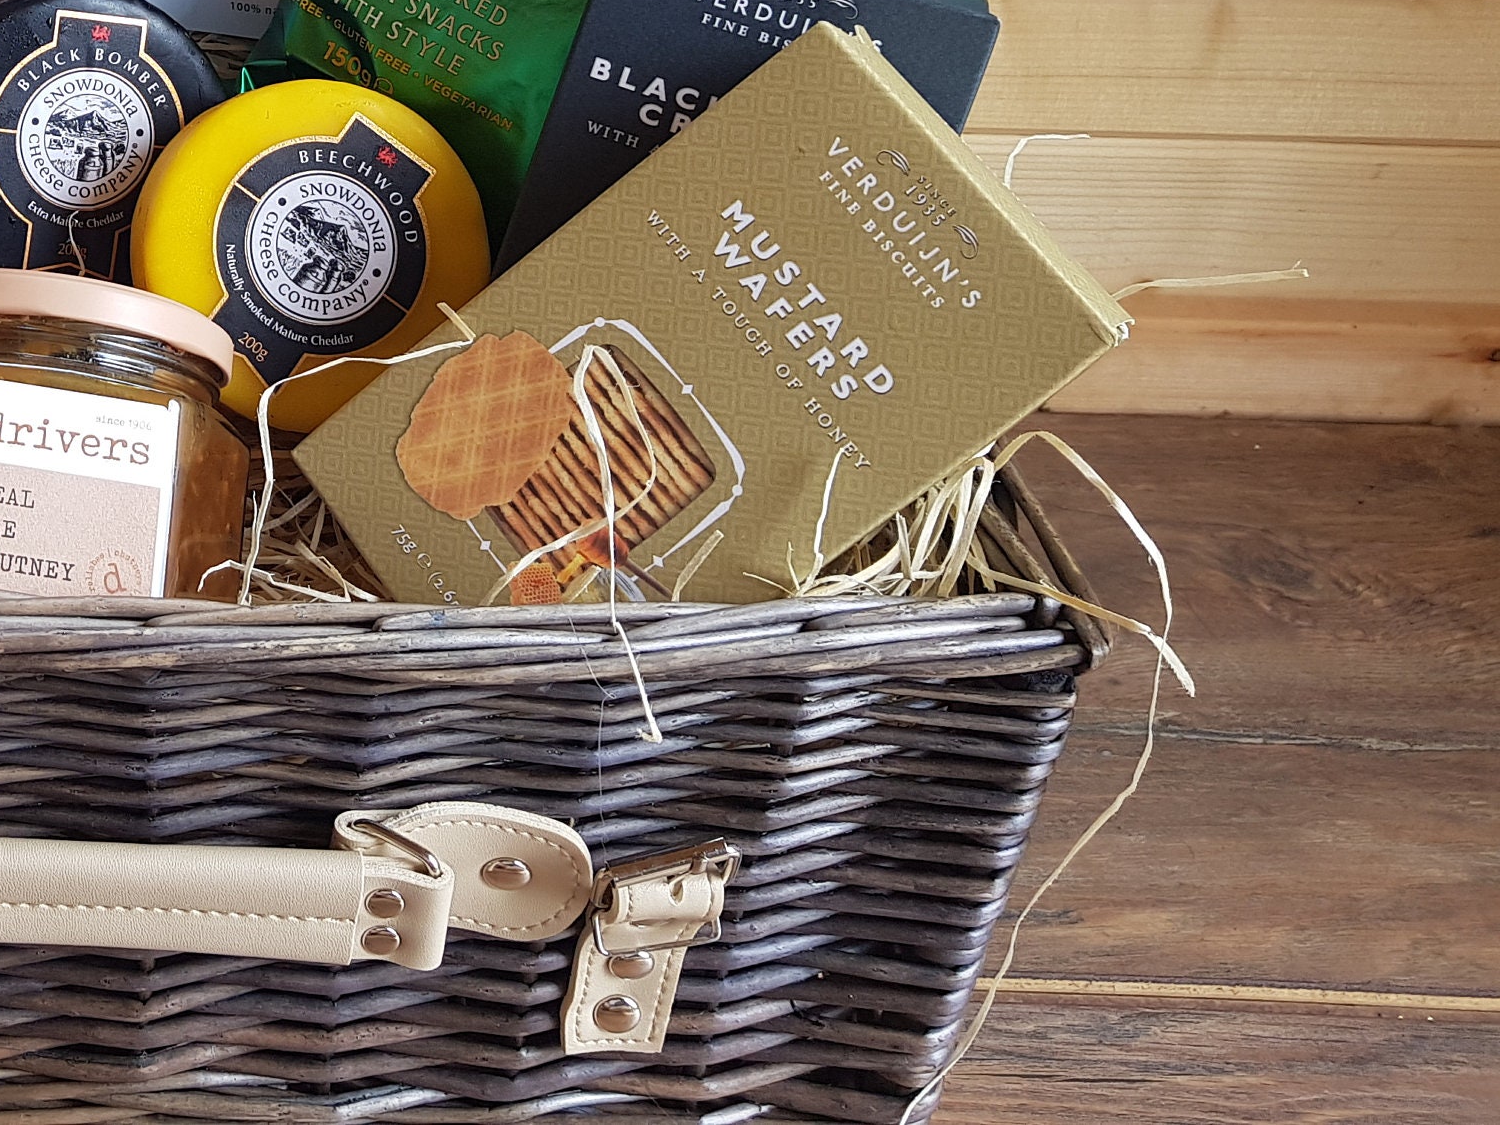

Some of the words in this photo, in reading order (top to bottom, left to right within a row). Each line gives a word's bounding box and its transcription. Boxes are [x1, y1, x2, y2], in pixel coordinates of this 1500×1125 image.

[230, 1, 261, 14] 100%
[701, 12, 752, 38] FINE
[323, 40, 372, 88] 150g
[333, 18, 375, 53] GLUTEN
[375, 48, 412, 75] FREE
[423, 75, 514, 131] VEGETARIAN
[387, 21, 466, 76] STYLE
[17, 48, 81, 92] BLACK
[94, 48, 167, 107] BOMBER
[590, 57, 718, 111] BLAC
[587, 120, 640, 148] WITH
[27, 200, 49, 220] Extra
[86, 211, 125, 228] Cheddar
[298, 149, 419, 243] BEECHWOOD
[826, 136, 982, 309] VERDUIJN'S
[904, 185, 947, 227] 1935
[916, 175, 956, 217] SINCE
[819, 170, 862, 216] FINE
[862, 219, 945, 310] BISCUITS
[225, 243, 245, 292] Naturally
[240, 291, 273, 327] Smoked
[271, 322, 309, 344] Mature
[310, 333, 355, 347] Cheddar
[713, 231, 860, 401] WAFERS
[721, 199, 895, 395] MUSTARD
[237, 331, 269, 363] 200g
[647, 209, 691, 262] WITH
[691, 267, 707, 283] A
[711, 286, 774, 357] TOUCH
[775, 362, 804, 390] OF
[803, 397, 872, 471] HONEY
[96, 415, 125, 427] since
[391, 524, 418, 554] 75g
